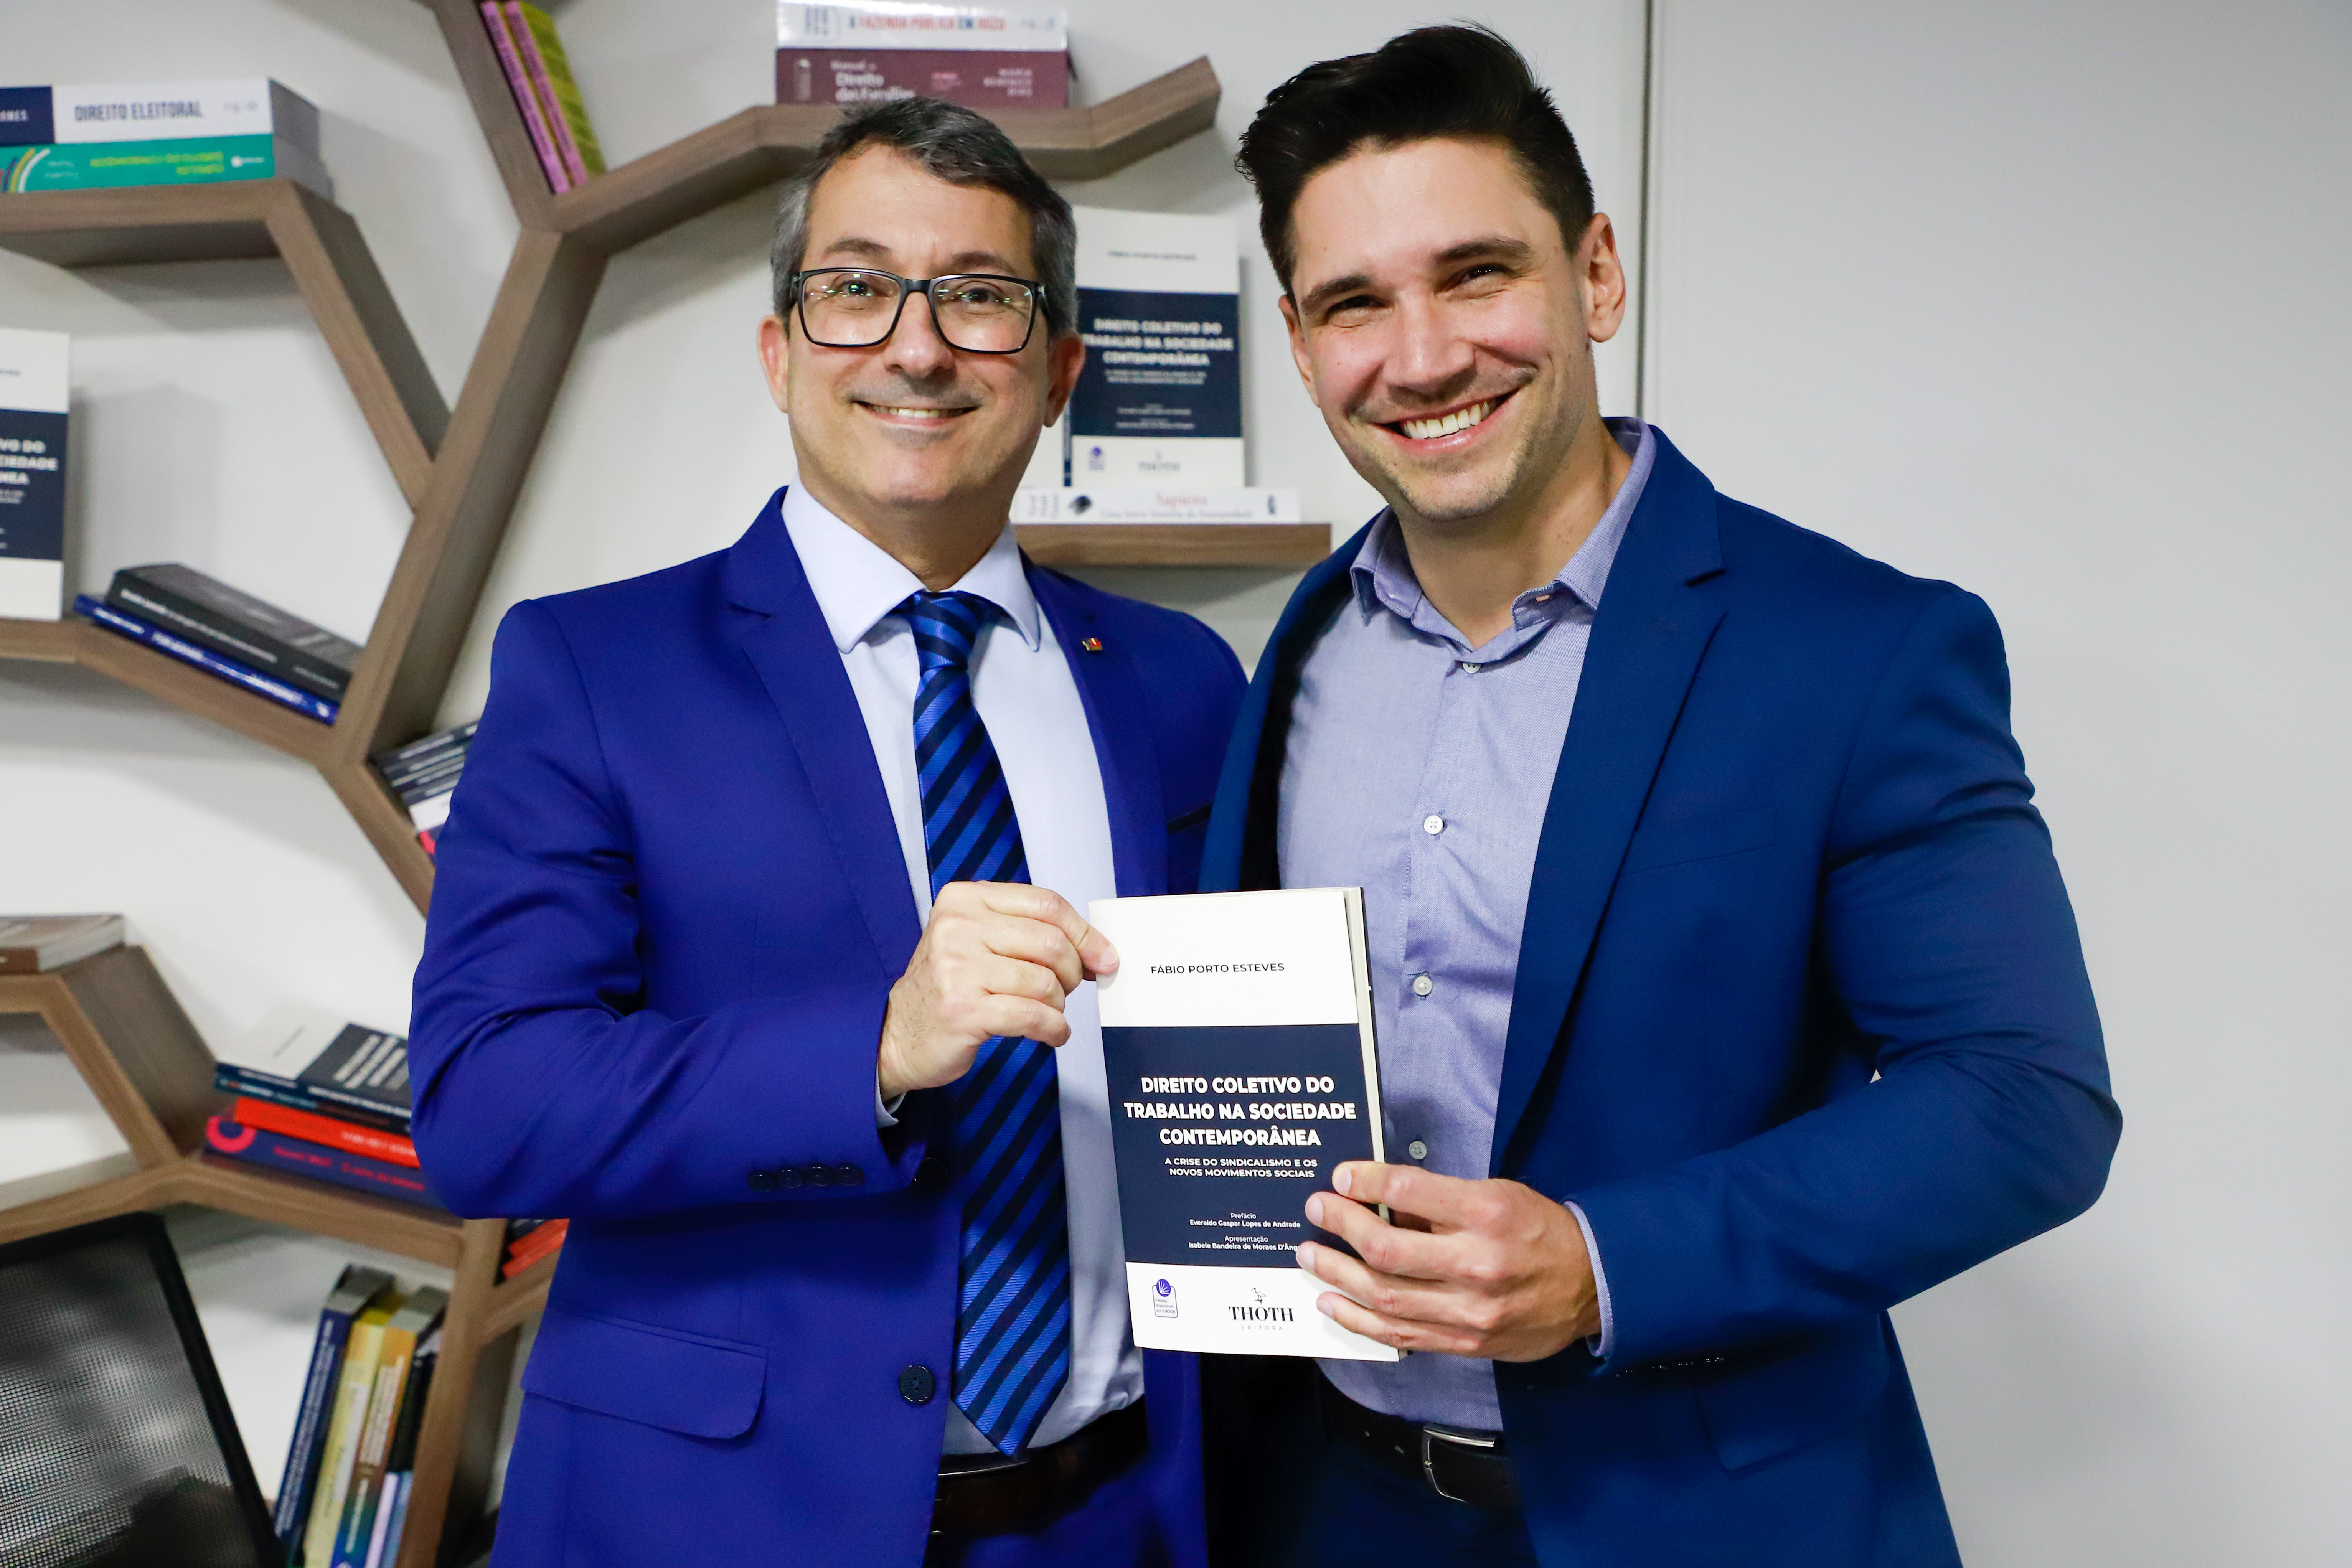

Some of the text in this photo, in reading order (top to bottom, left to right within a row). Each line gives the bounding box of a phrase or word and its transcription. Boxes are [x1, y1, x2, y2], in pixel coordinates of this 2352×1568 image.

[0, 109, 28, 122] OMES
[75, 104, 126, 122] DIREITO
[131, 101, 203, 120] ELEITORAL
[1094, 318, 1222, 335] DIREITO COLETIVO DO
[1143, 337, 1162, 349] NA
[1163, 337, 1234, 351] SOCIEDADE
[0, 455, 58, 471] IEDADE
[1151, 963, 1284, 974] FÁBIO PORTO ESTEVES
[1141, 1076, 1334, 1093] DIREITO COLETIVO DO
[1124, 1103, 1356, 1120] TRABALHO NA SOCIEDADE
[1160, 1125, 1321, 1146] CONTEMPORÂNEA
[1278, 1243, 1300, 1252] D'Âng
[1229, 1306, 1295, 1322] THOTH
